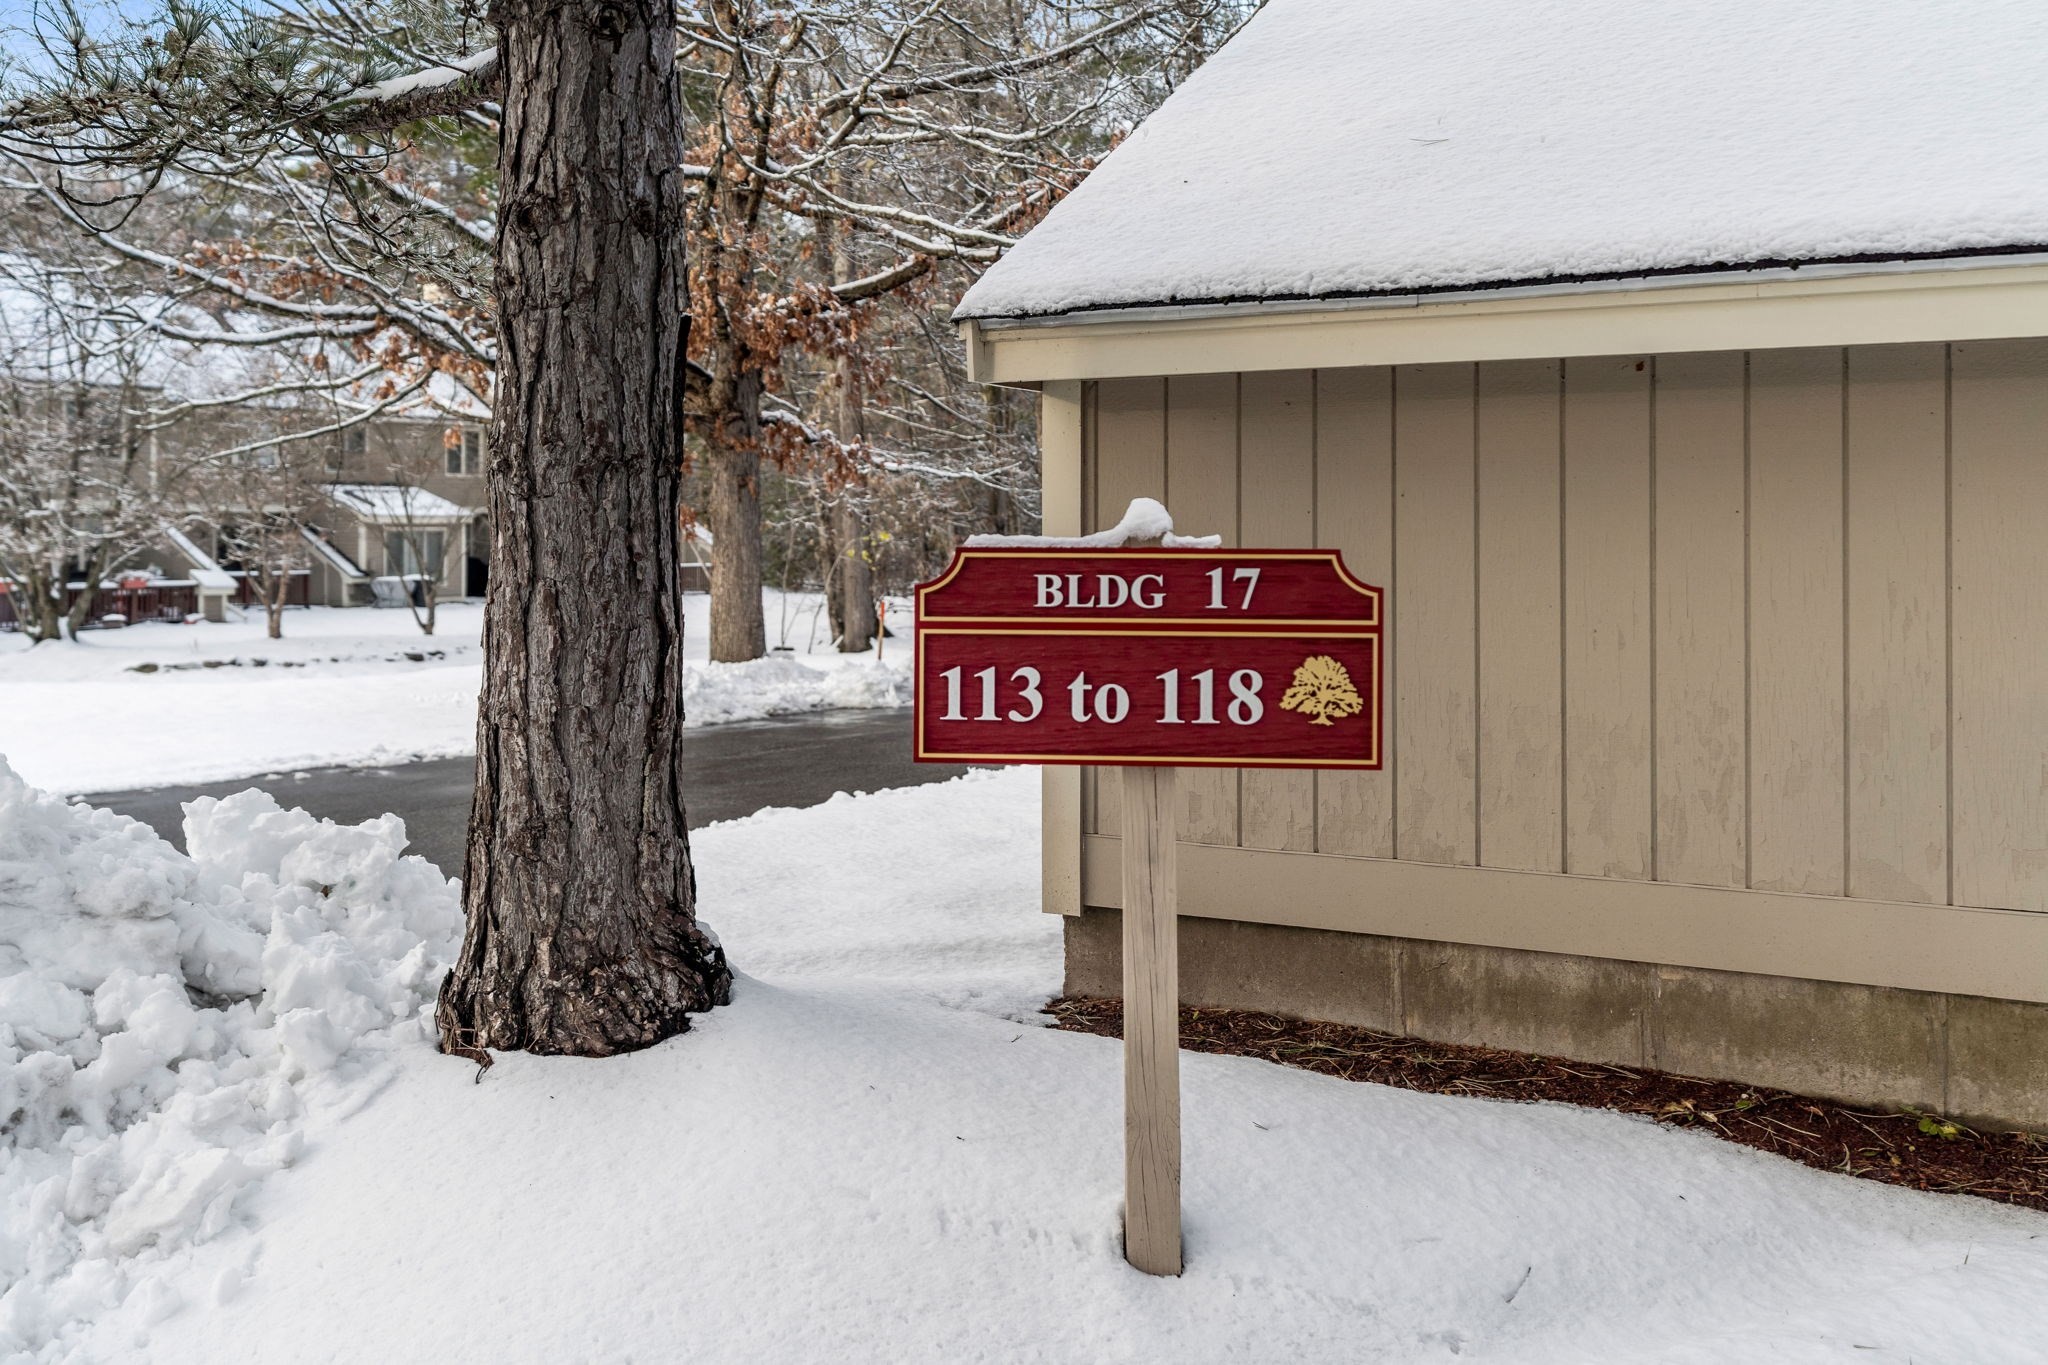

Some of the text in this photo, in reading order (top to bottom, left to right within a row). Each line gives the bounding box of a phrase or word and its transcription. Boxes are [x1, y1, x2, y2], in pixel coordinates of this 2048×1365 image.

[1034, 567, 1260, 610] BLDG 17
[939, 666, 1264, 725] 113 to 118
